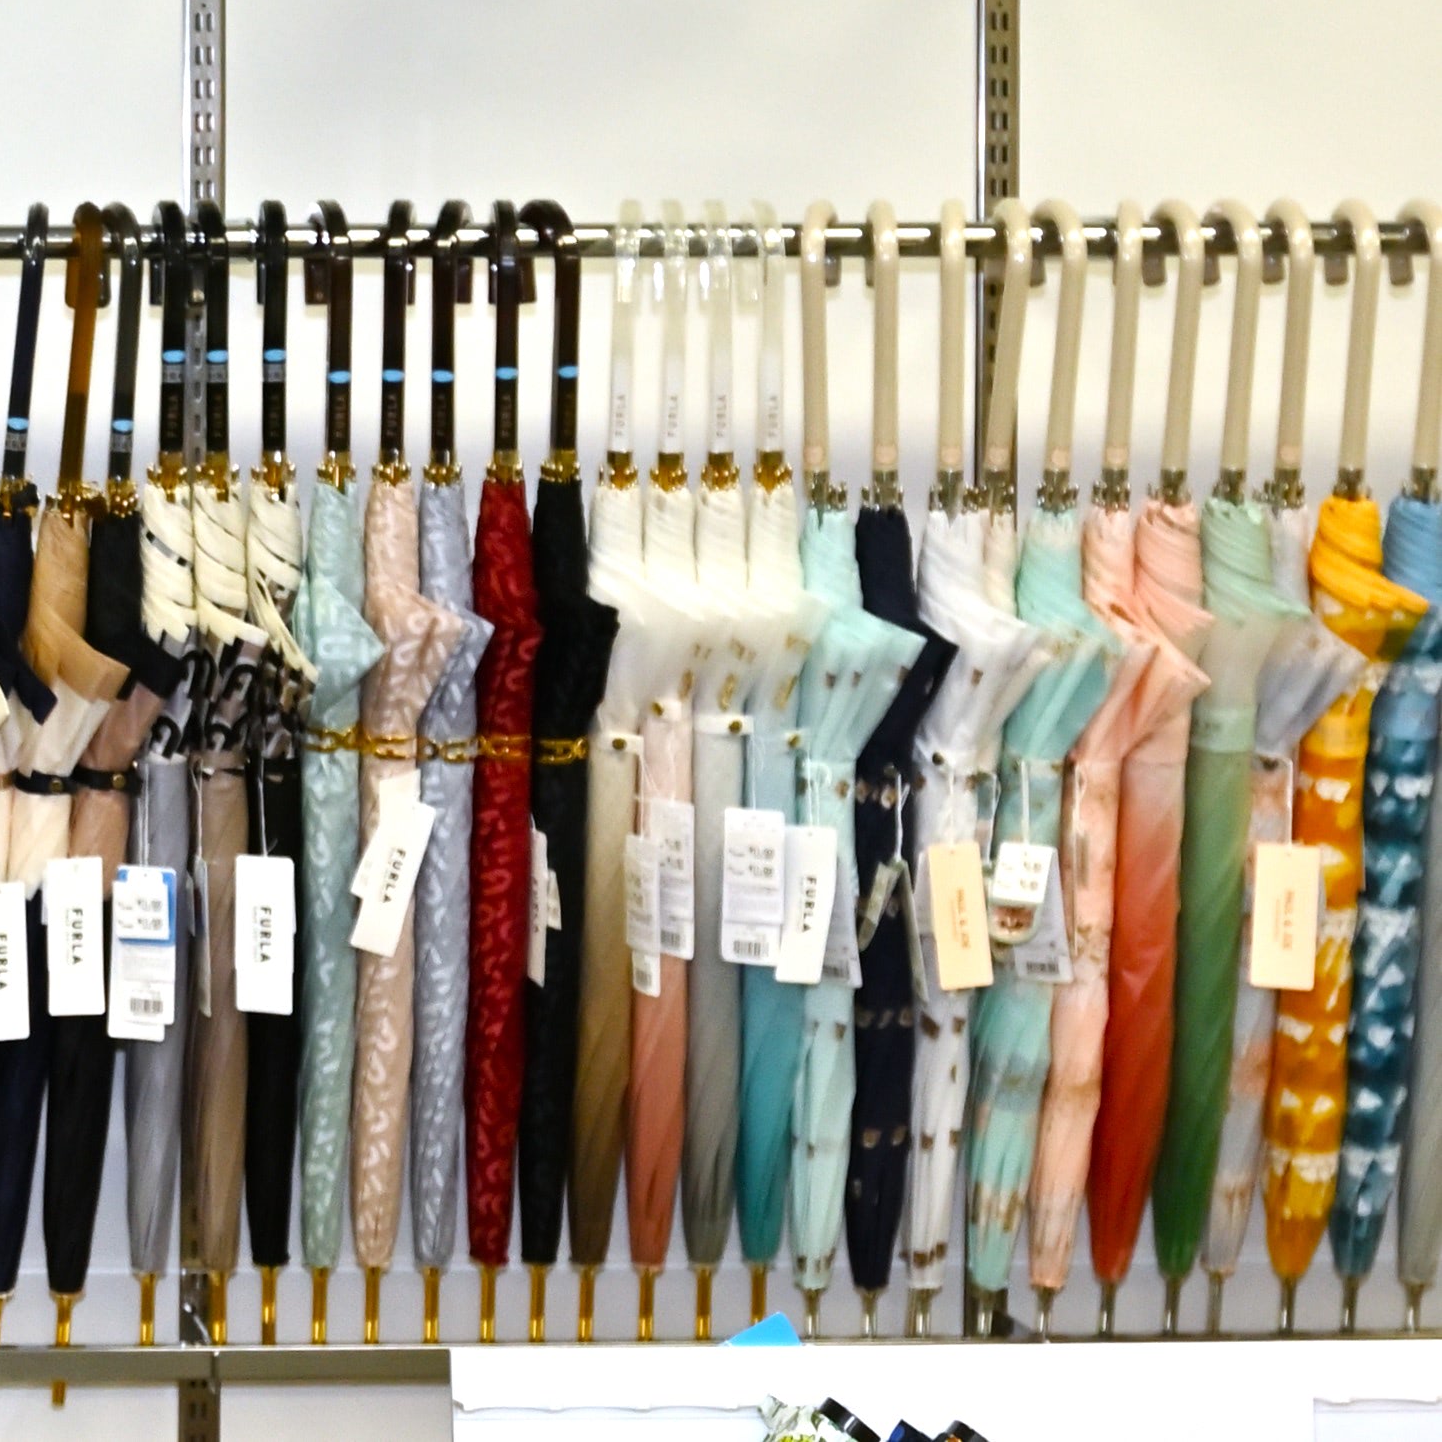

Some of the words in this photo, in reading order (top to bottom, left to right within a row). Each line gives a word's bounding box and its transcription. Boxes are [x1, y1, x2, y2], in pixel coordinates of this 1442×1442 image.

[382, 848, 406, 904] FURLA
[802, 876, 818, 933] FURLA
[71, 907, 83, 965] FURLA
[259, 906, 272, 963] FURLA
